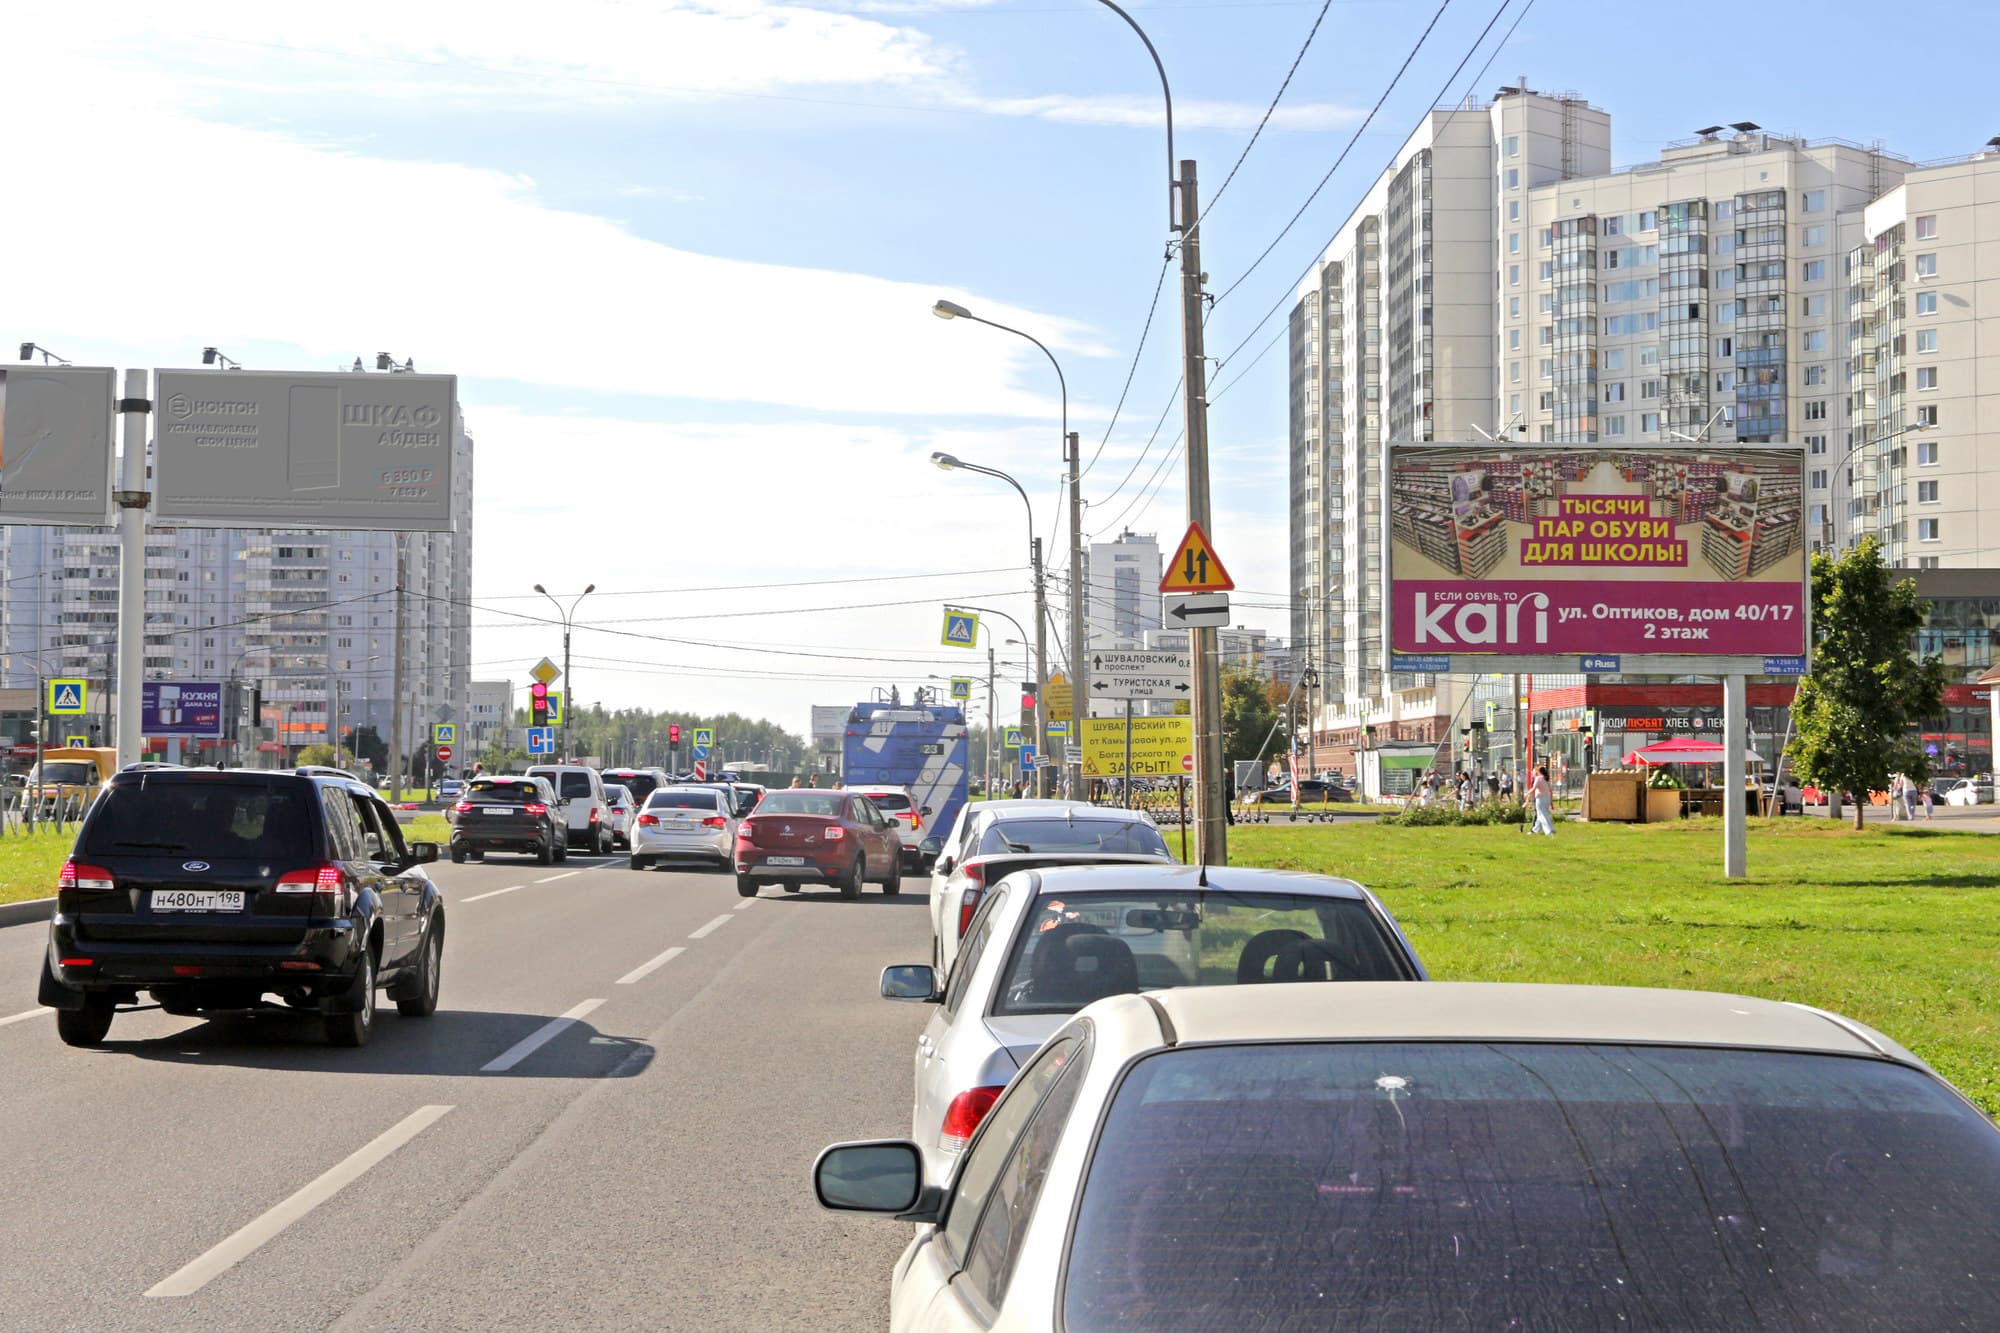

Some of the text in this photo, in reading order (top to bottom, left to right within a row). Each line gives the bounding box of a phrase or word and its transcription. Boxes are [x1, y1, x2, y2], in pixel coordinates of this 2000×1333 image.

[343, 404, 441, 429] ШКАФ
[377, 429, 440, 448] АЙДЕН
[1562, 499, 1645, 514] ТЫСЯЧИ
[1538, 520, 1670, 538] ПАР ОБУВИ
[1523, 543, 1683, 563] ДЛЯ ШКОЛЫ!
[1434, 592, 1518, 602] ЕСЛИ ОБУВЬ, ТО
[1414, 592, 1550, 644] kari
[1557, 603, 1794, 623] ул. Оптиков, дом 40/17
[1643, 623, 1709, 639] 2 этаж
[1104, 654, 1177, 664] ШУВАЛОВСКИЙ
[1594, 659, 1617, 668] Russ
[1104, 664, 1145, 672] проспект
[1113, 678, 1171, 687] ТУРИСТСКАЯ
[182, 692, 218, 700] КУХНЯ
[1129, 688, 1153, 696] улица
[1665, 717, 1689, 728] ХЛЕБ
[1159, 737, 1173, 745] ул.
[1175, 736, 1187, 744] до
[923, 744, 938, 754] 23
[218, 892, 241, 904] 198
